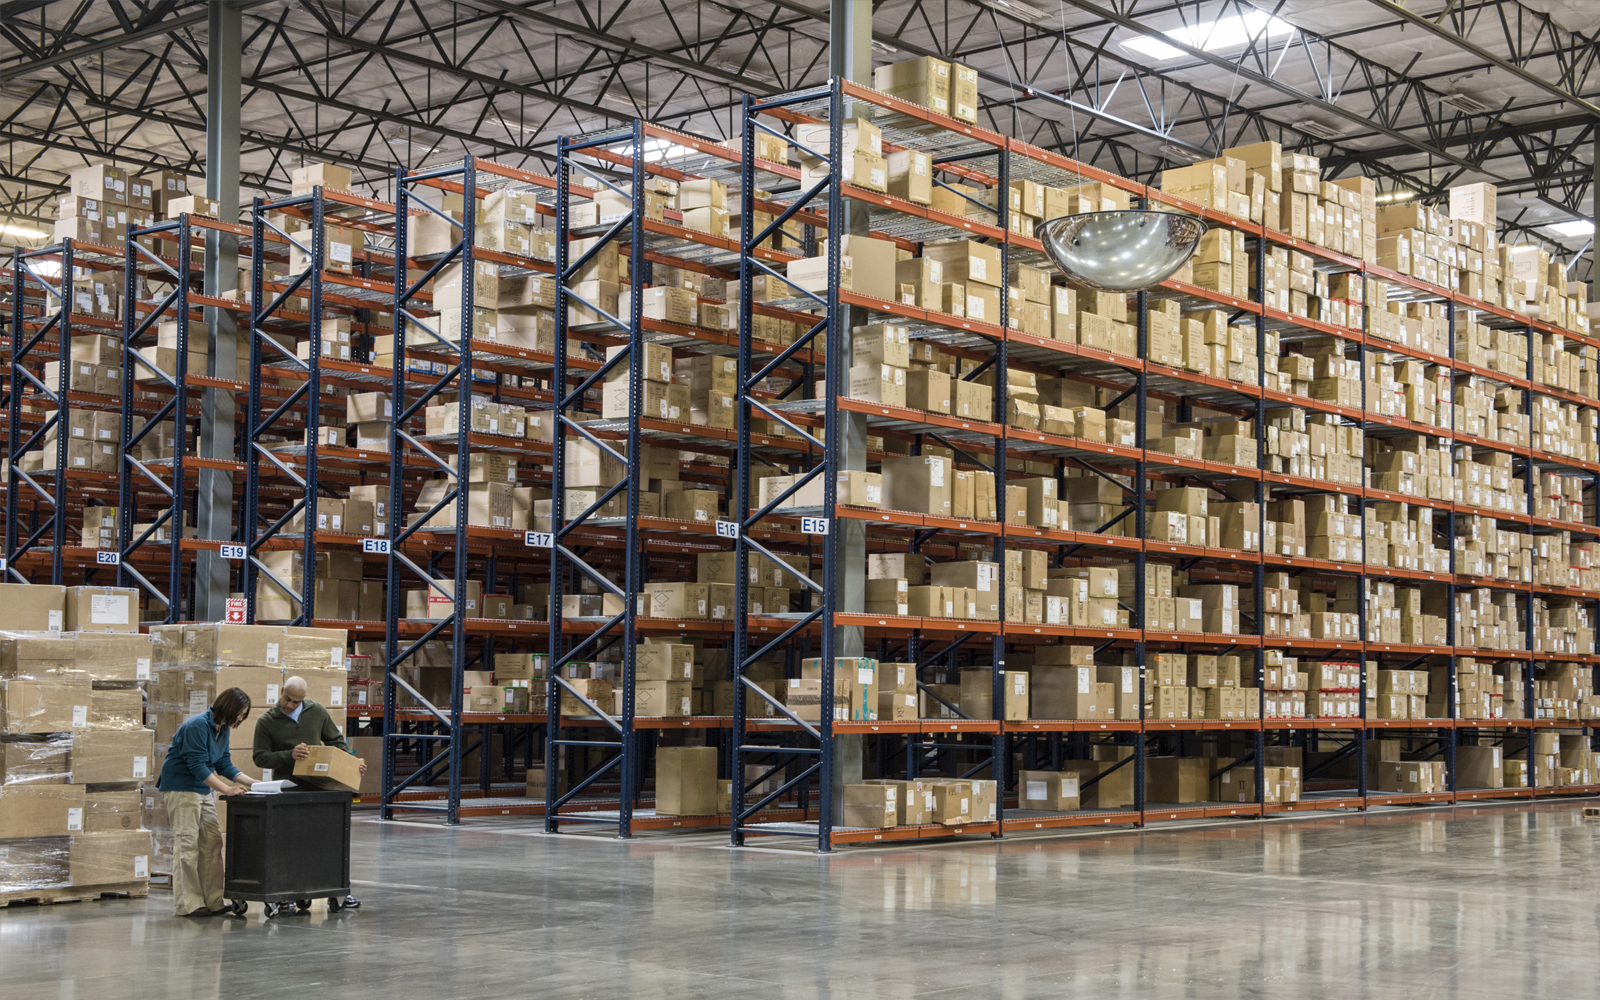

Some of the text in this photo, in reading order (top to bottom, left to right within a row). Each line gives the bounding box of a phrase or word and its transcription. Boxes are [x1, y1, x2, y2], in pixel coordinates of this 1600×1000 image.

[717, 522, 736, 537] E16
[803, 518, 825, 533] E15
[527, 533, 550, 546] E17
[221, 546, 244, 557] E19
[365, 540, 387, 552] E18
[98, 552, 117, 563] E20
